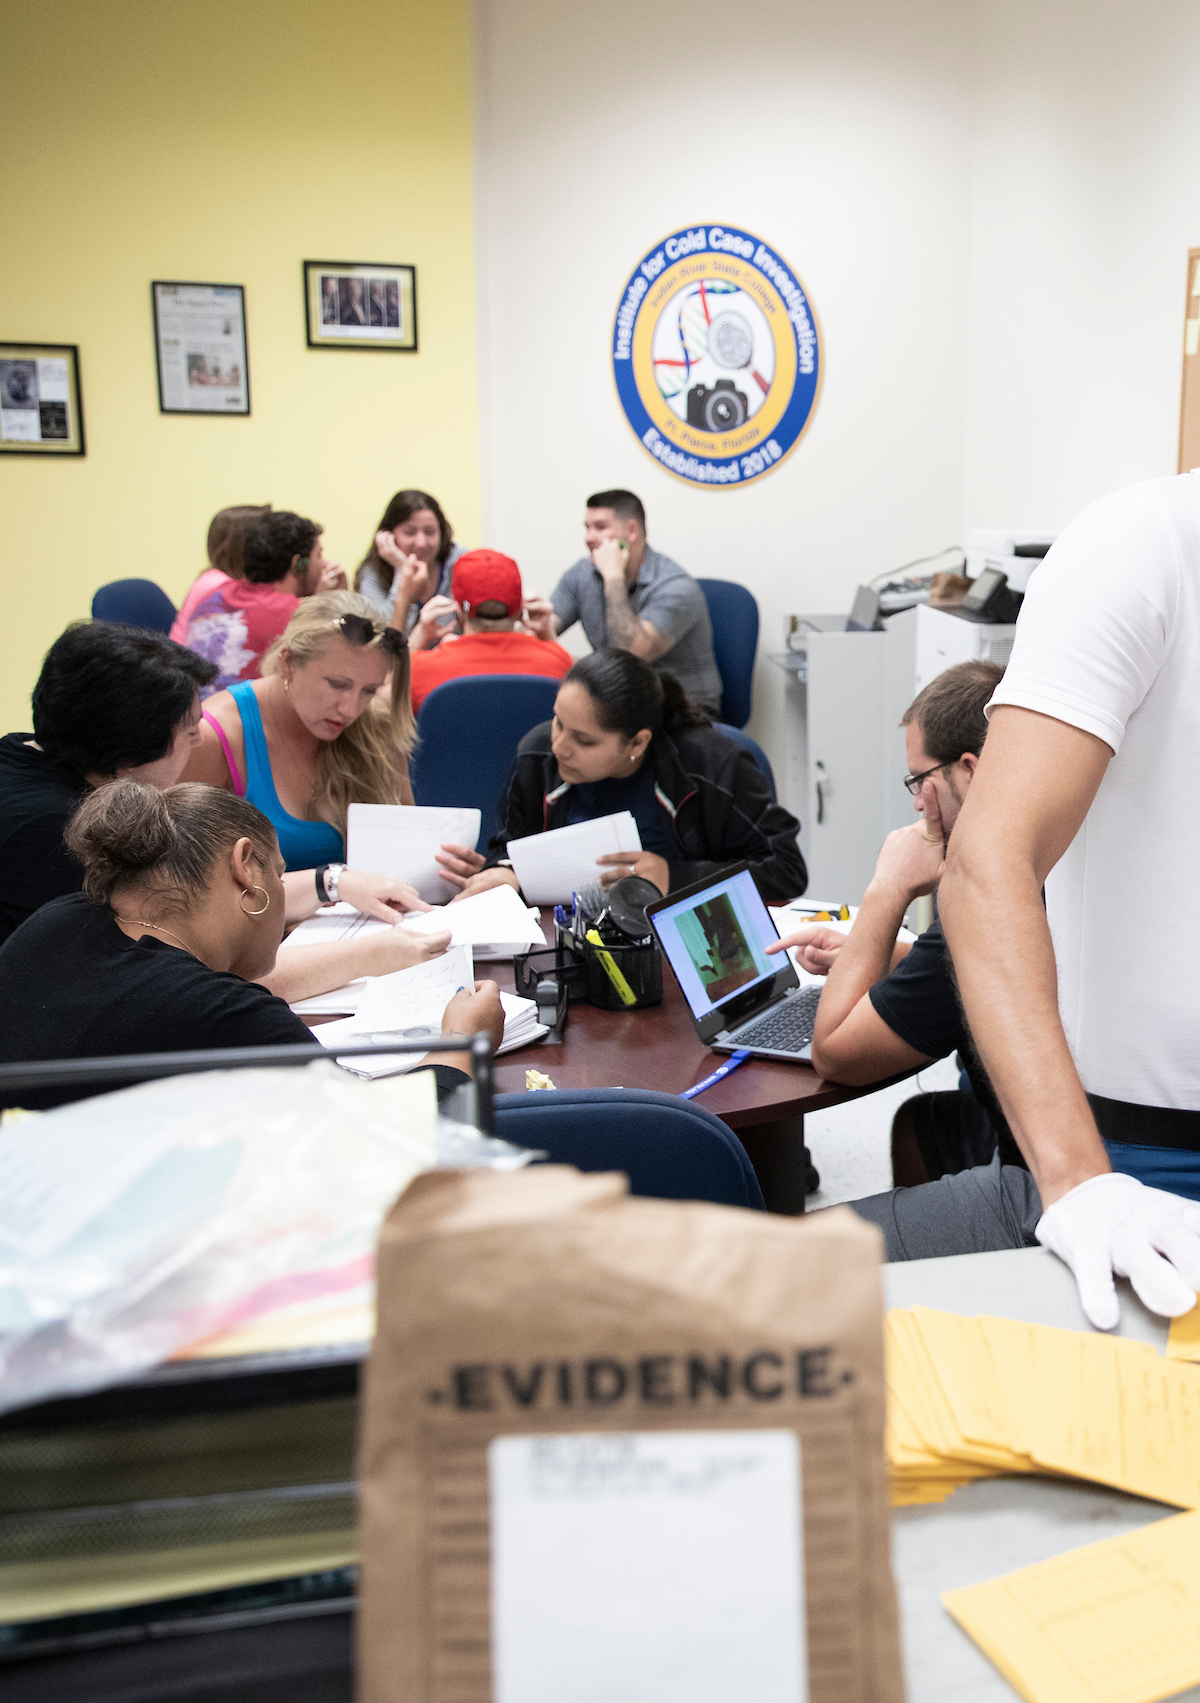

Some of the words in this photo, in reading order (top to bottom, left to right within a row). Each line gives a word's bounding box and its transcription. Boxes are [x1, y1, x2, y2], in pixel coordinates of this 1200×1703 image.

[614, 276, 648, 360] Institute
[641, 252, 667, 281] for
[664, 228, 707, 260] Cold
[708, 227, 755, 258] Case
[753, 245, 817, 374] Investigation
[642, 427, 740, 483] Established
[451, 1345, 837, 1412] EVIDENCE
